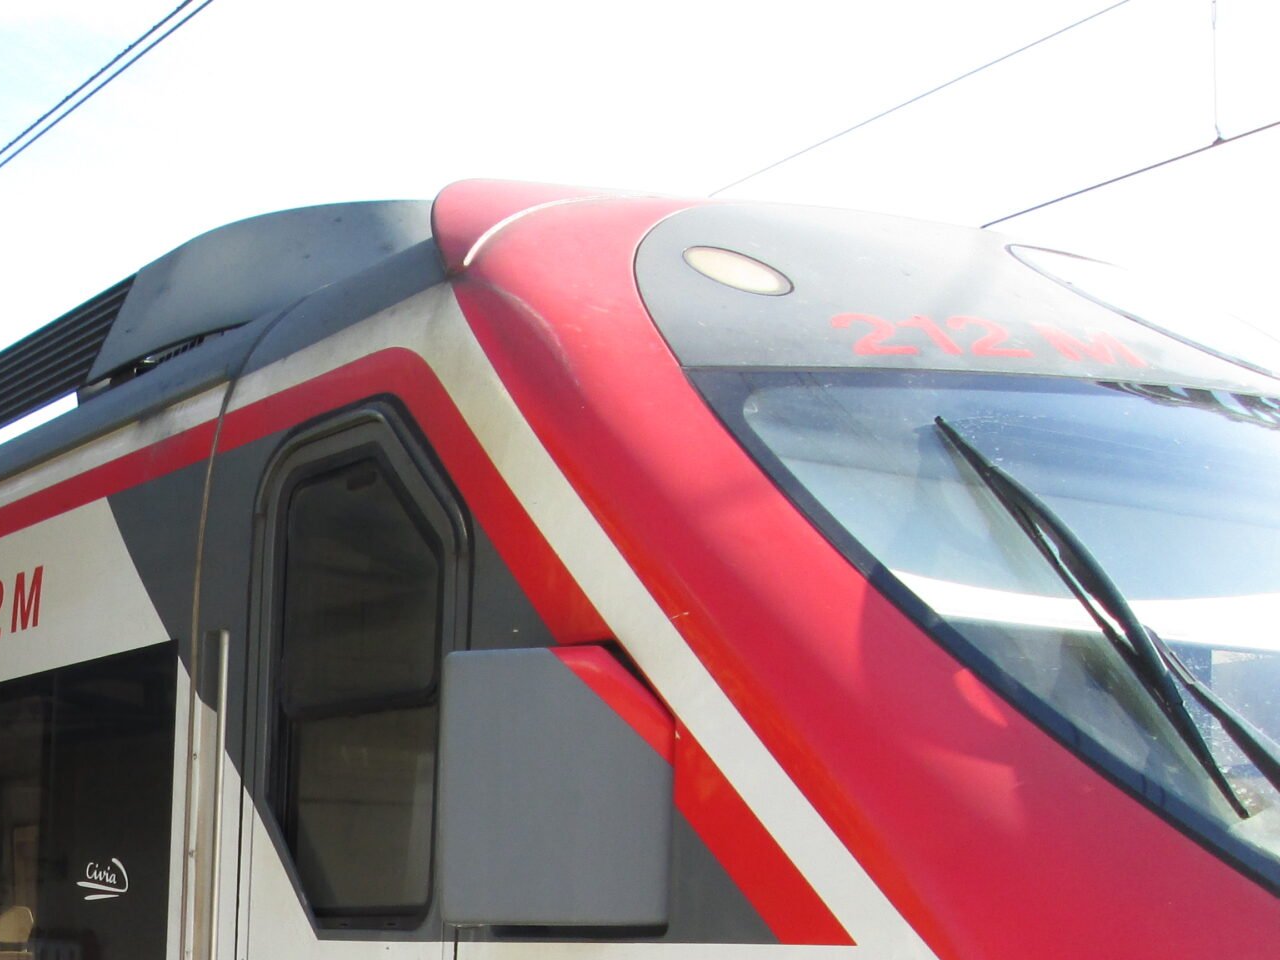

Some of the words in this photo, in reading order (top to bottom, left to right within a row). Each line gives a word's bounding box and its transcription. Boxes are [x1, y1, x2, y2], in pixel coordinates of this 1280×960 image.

[830, 312, 1034, 359] 212
[1031, 320, 1149, 369] M
[11, 565, 44, 634] M
[86, 862, 117, 885] Civia
